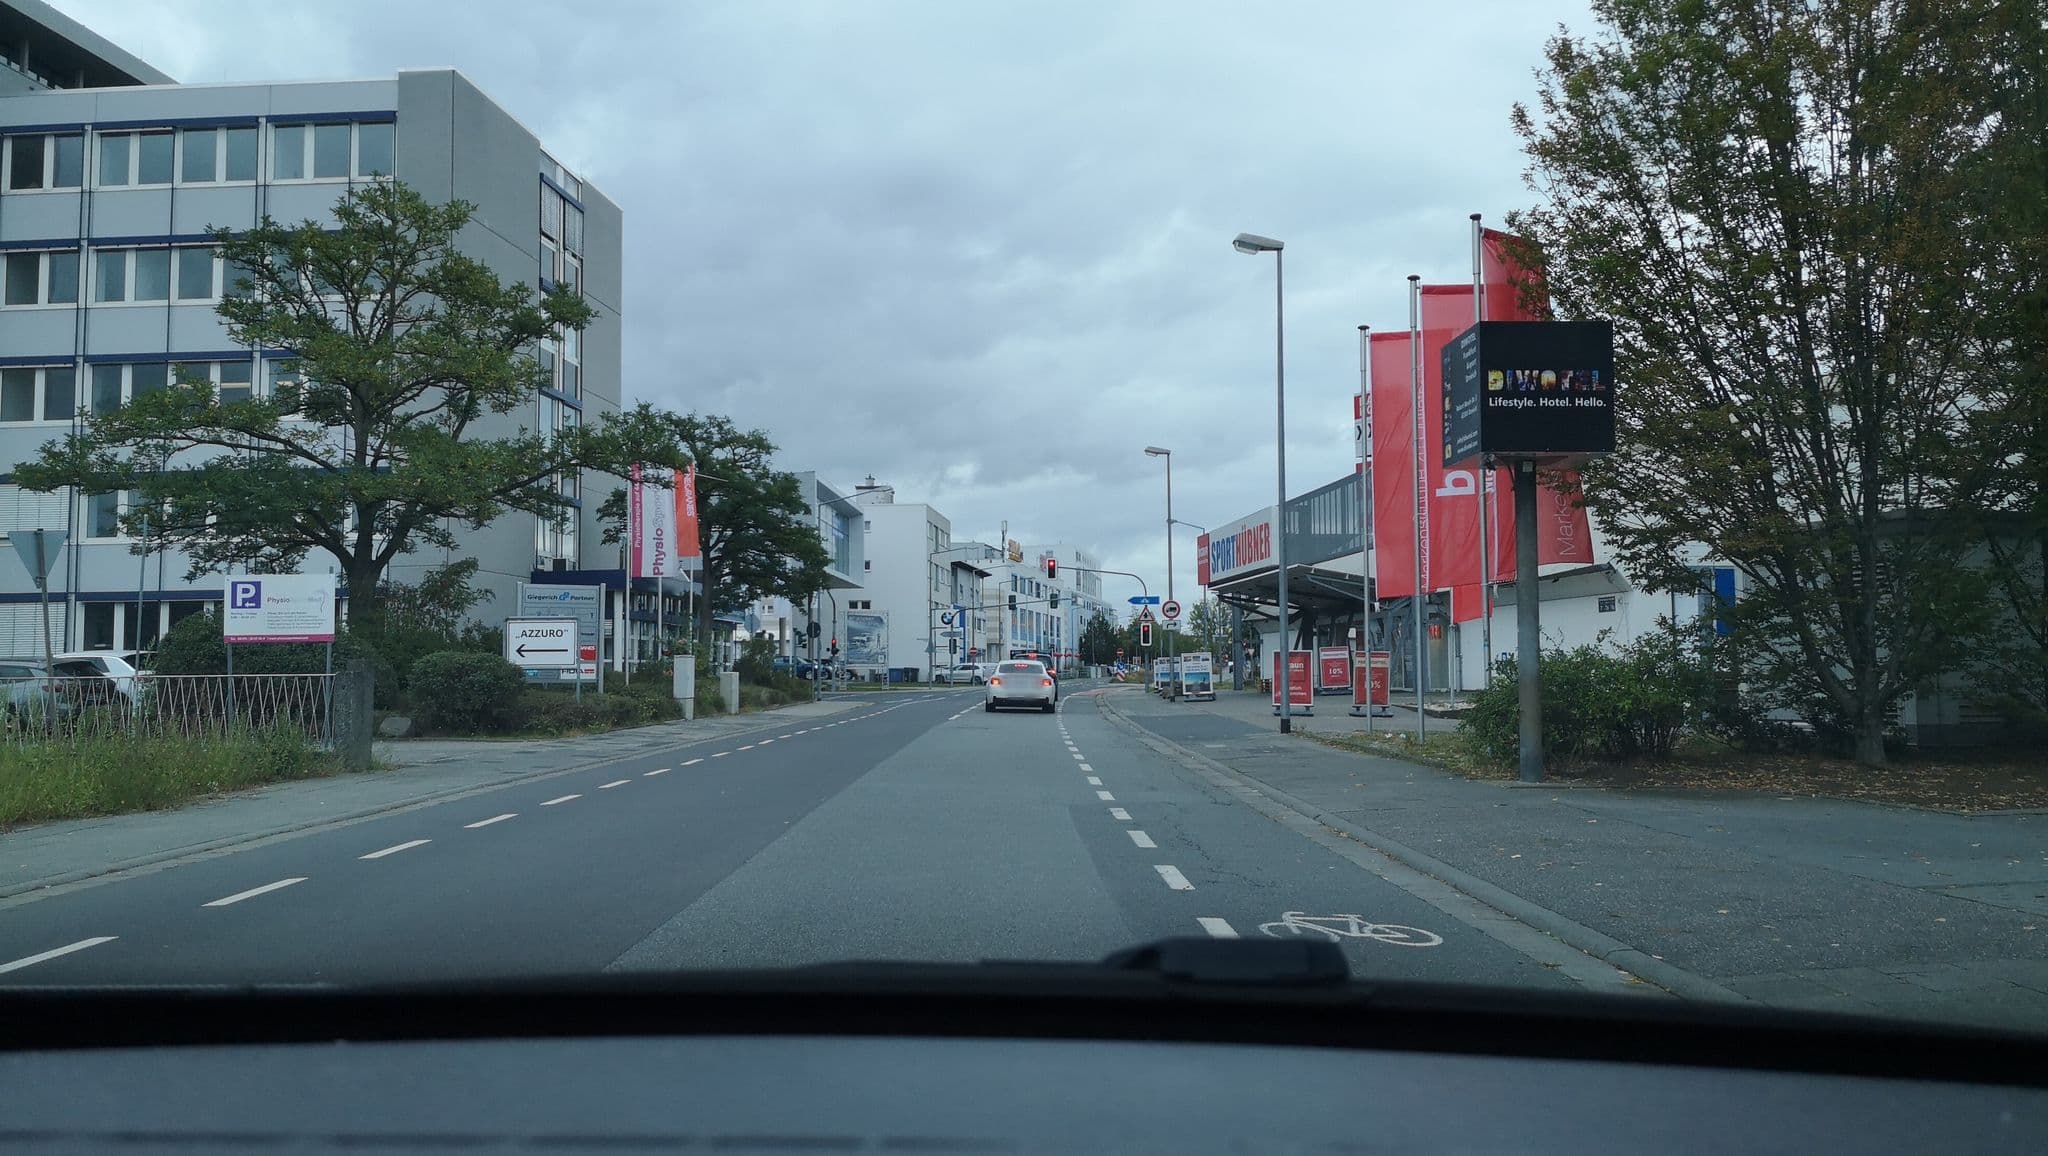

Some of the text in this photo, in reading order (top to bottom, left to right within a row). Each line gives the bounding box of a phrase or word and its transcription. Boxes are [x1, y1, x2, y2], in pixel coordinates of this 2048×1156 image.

[1488, 397, 1536, 408] Lifestyle.
[1539, 397, 1573, 407] Hotel.
[1575, 397, 1607, 407] Hello.
